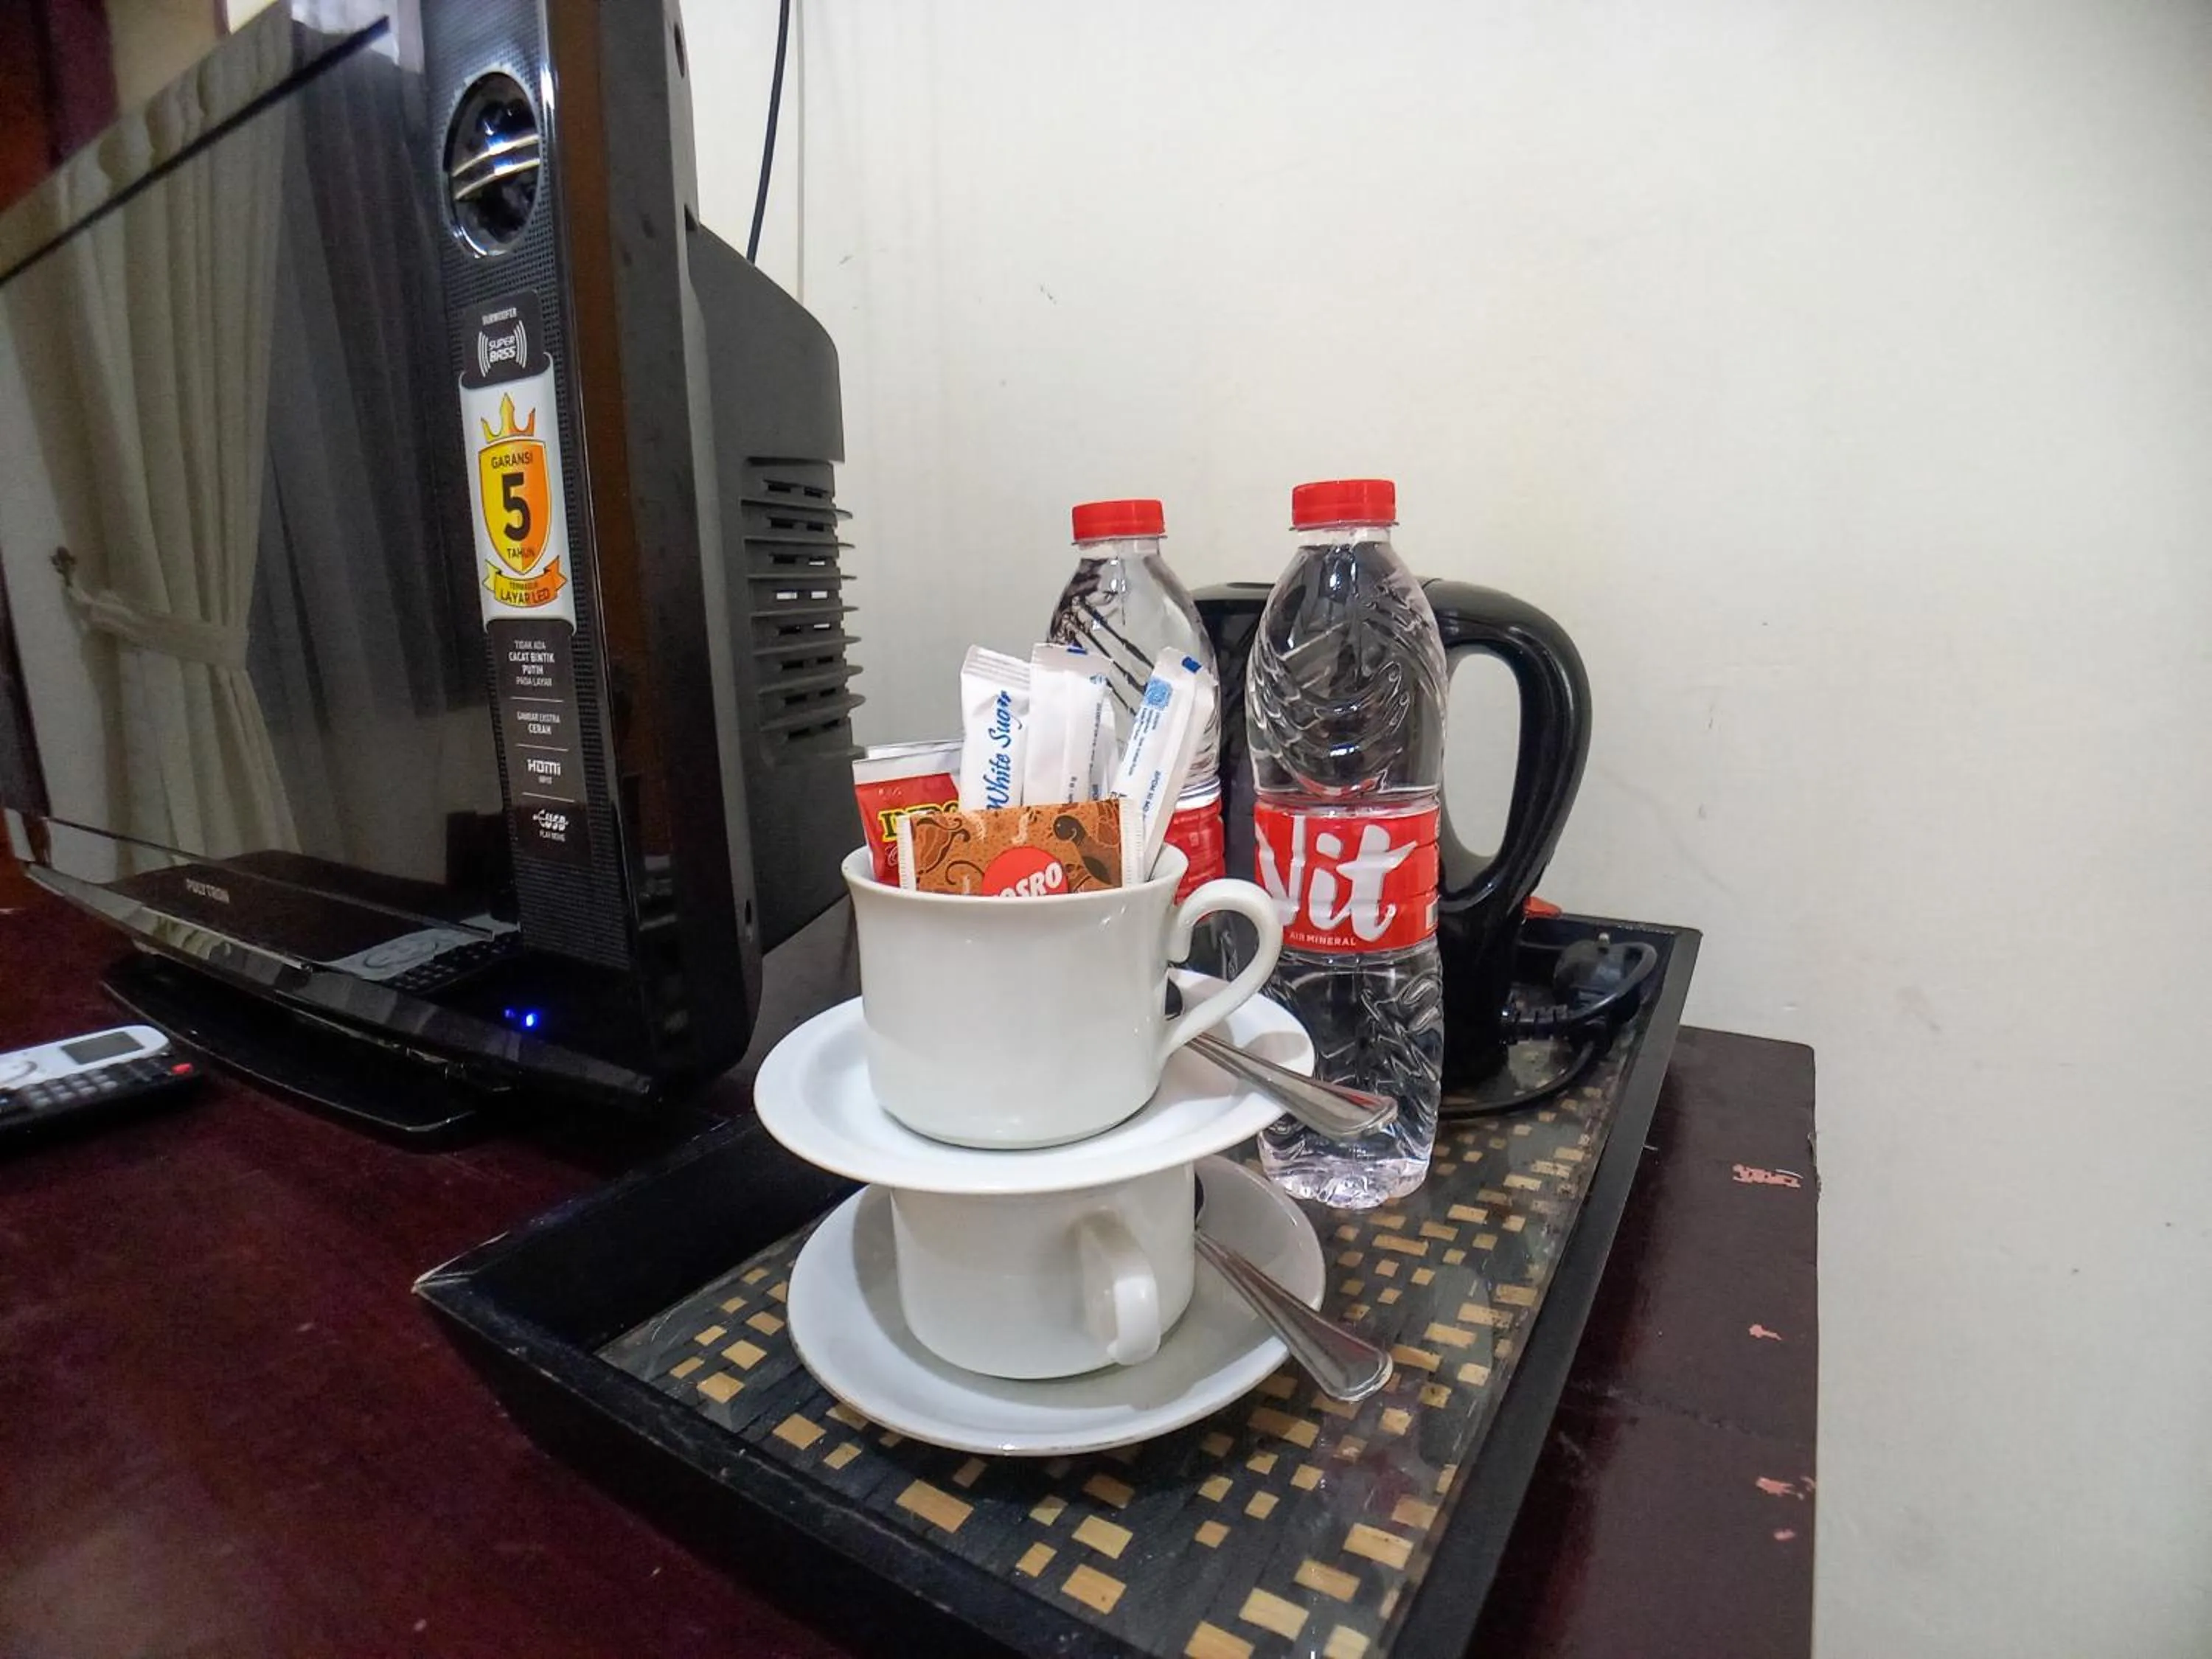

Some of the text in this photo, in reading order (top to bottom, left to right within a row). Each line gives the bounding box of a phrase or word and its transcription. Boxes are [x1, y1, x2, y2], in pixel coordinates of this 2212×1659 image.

[489, 335, 515, 351] SUPER
[489, 346, 516, 363] BASS
[491, 452, 533, 470] GARANSI
[501, 471, 531, 542] 5
[507, 547, 535, 560] TAHUN
[501, 587, 551, 603] LAYAR LED
[983, 689, 1023, 810] White Sugar
[998, 861, 1062, 897] SRO
[1254, 814, 1418, 942] Vit
[1290, 931, 1357, 947] AIR MINERAL
